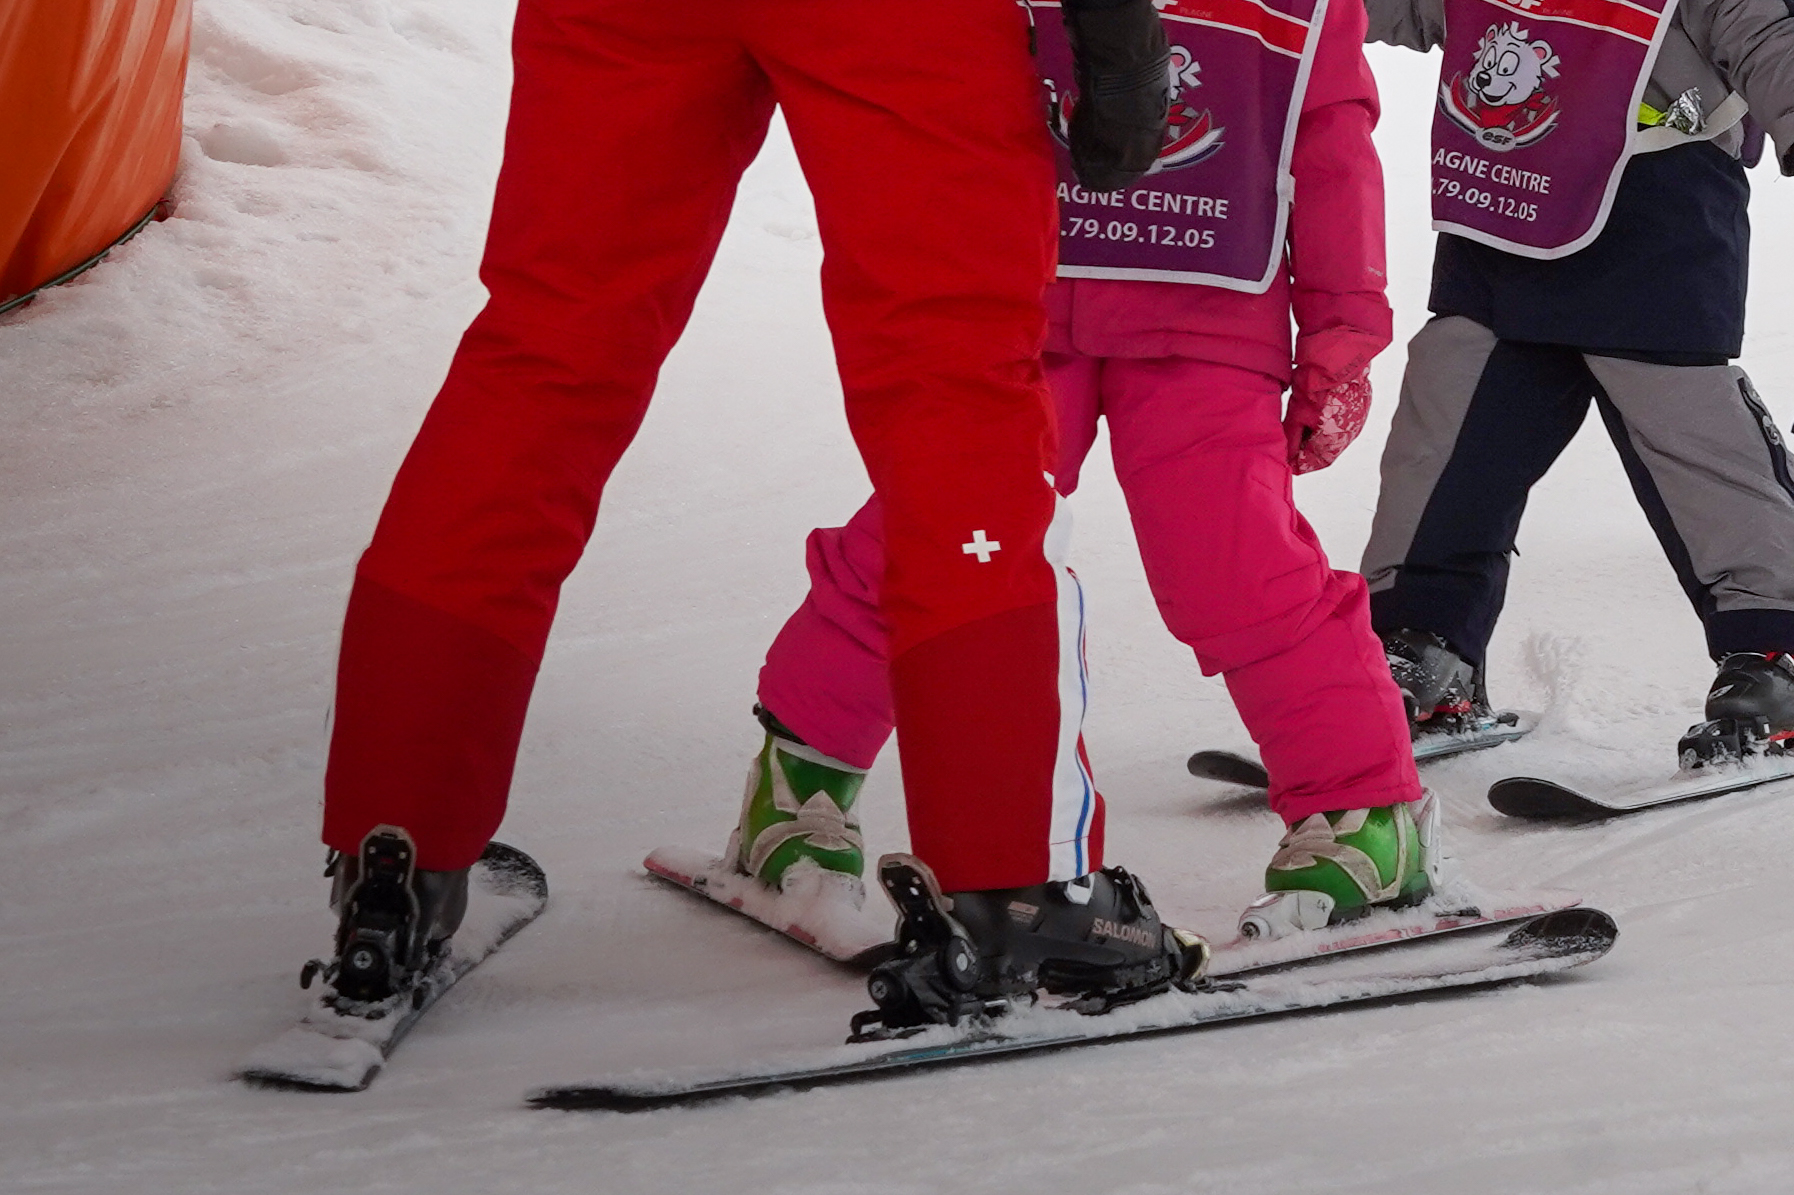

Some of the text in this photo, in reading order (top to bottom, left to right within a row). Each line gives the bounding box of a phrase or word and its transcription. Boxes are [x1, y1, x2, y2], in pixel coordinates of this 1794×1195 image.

[1491, 164, 1552, 195] CENTRE
[1130, 189, 1230, 219] CENTRE
[1092, 917, 1157, 949] SALOMON
